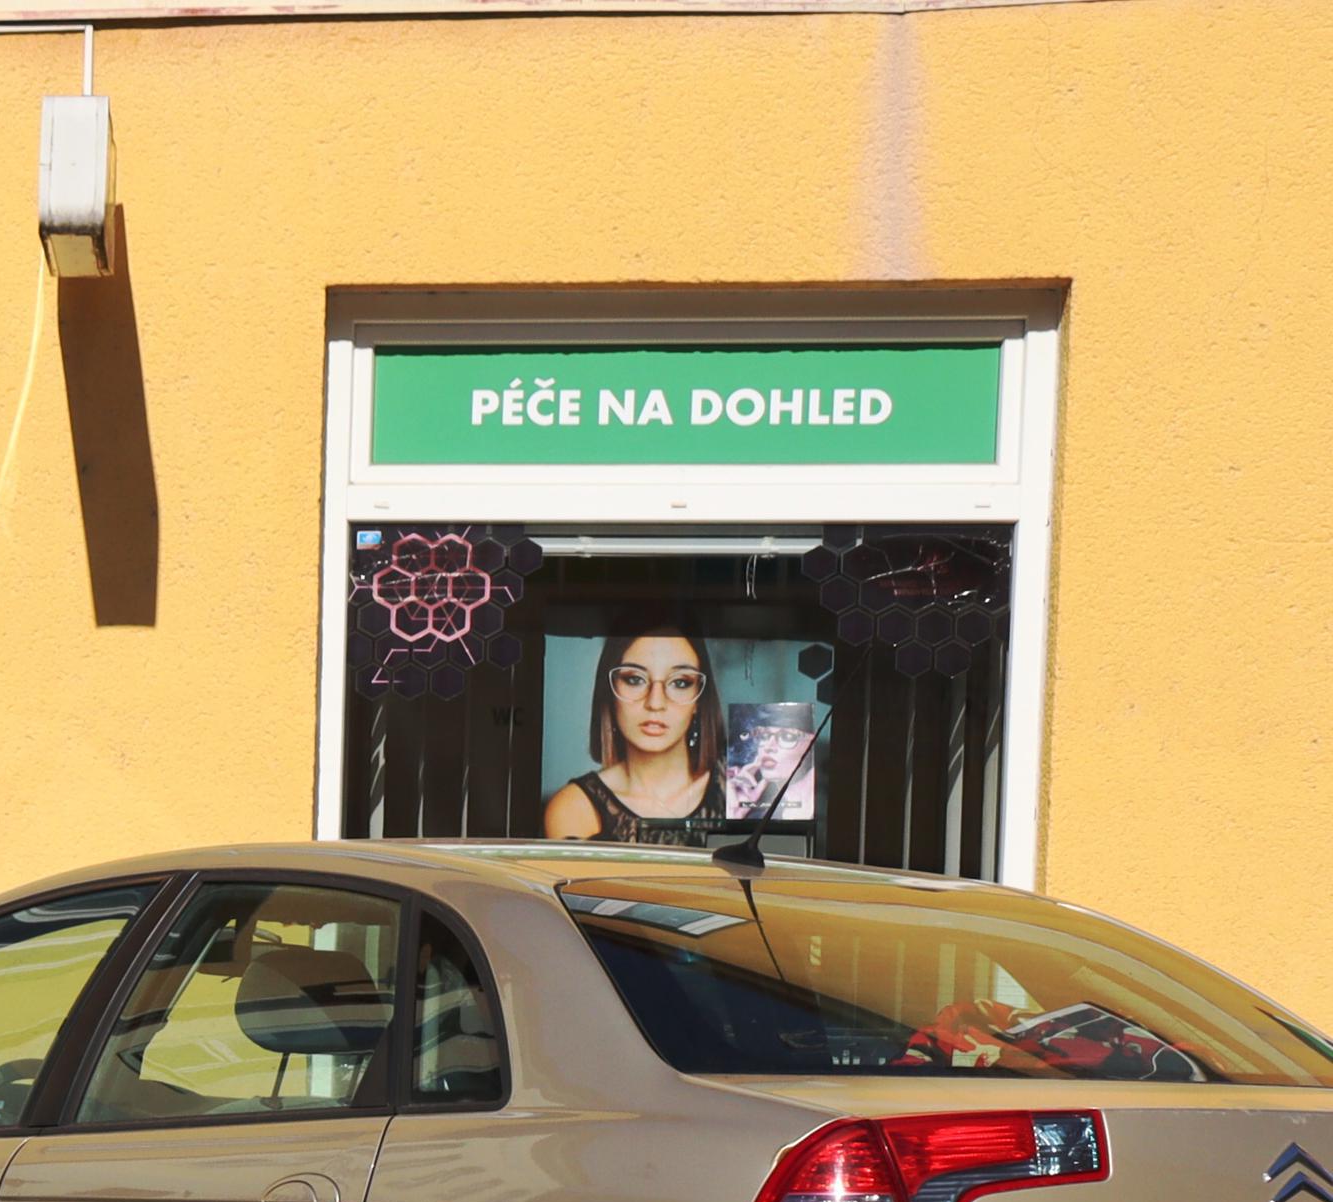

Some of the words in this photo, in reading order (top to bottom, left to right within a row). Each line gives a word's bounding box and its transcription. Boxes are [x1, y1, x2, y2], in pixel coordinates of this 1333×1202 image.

[470, 377, 581, 426] PÉČE
[597, 388, 674, 426] NA
[690, 387, 893, 426] DOHLED
